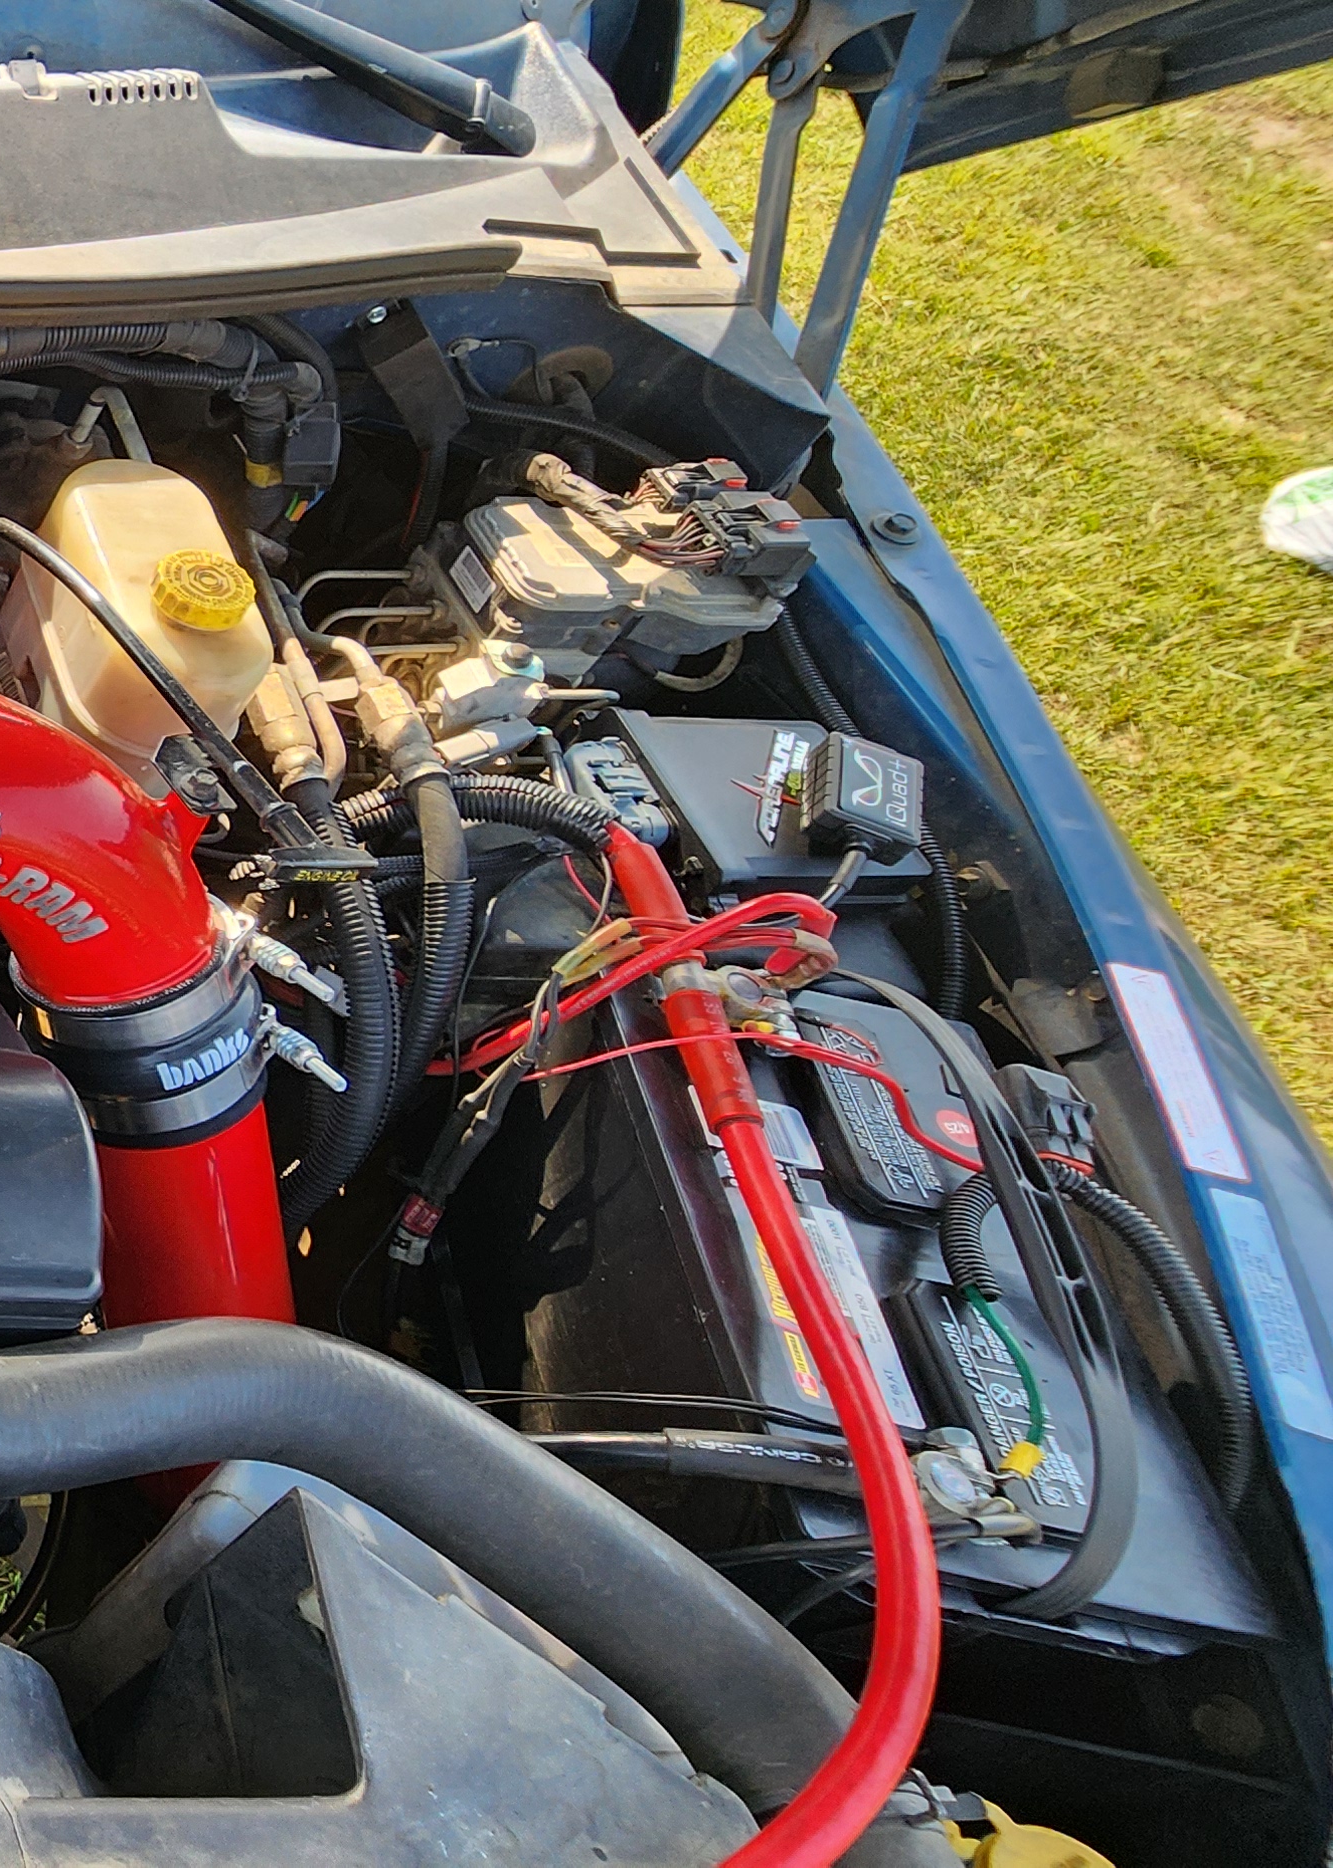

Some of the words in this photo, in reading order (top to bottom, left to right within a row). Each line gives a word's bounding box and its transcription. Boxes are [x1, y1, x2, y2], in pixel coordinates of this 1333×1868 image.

[758, 732, 794, 845] ADRENALINE
[884, 759, 908, 828] iQuad+
[293, 869, 343, 882] ENGINE
[156, 1027, 253, 1092] banks
[944, 1120, 971, 1135] 4/25
[828, 1217, 842, 1241] 1000
